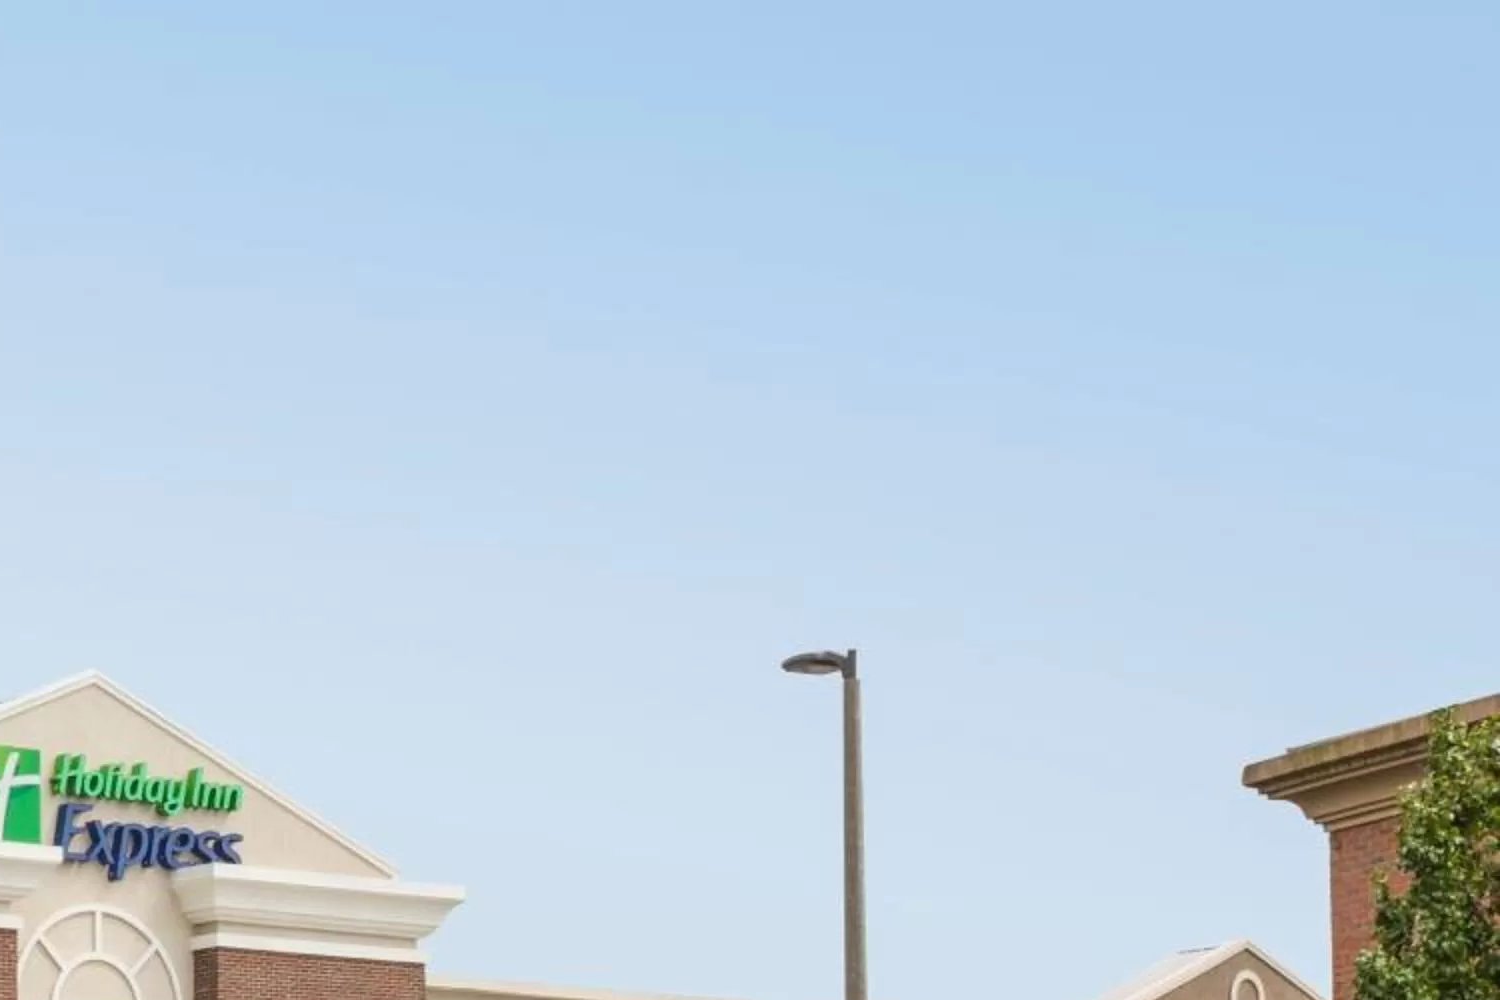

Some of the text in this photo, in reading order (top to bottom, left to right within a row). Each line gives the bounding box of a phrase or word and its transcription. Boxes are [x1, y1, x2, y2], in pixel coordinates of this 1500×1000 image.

[50, 752, 244, 816] Holiday Inn
[54, 803, 243, 880] Express
